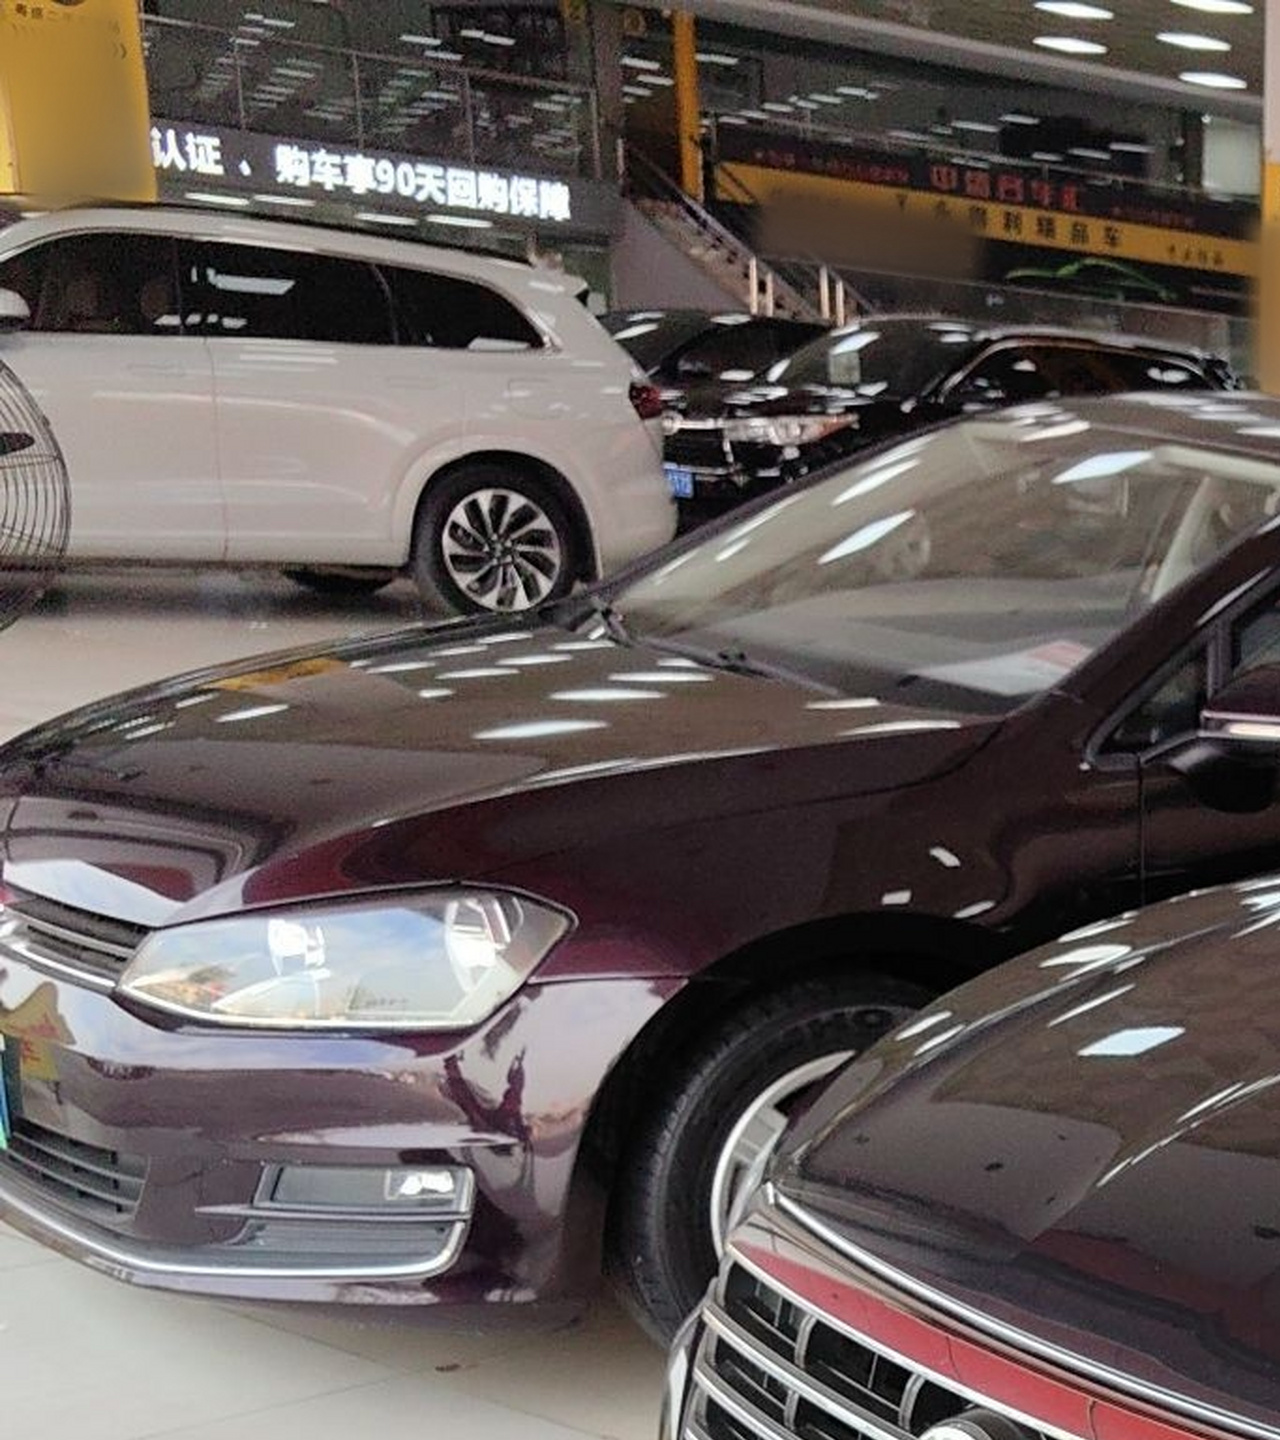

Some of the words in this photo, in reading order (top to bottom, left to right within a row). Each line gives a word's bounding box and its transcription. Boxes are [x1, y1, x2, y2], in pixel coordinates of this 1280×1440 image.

[274, 143, 571, 222] 购车享90天回购保障
